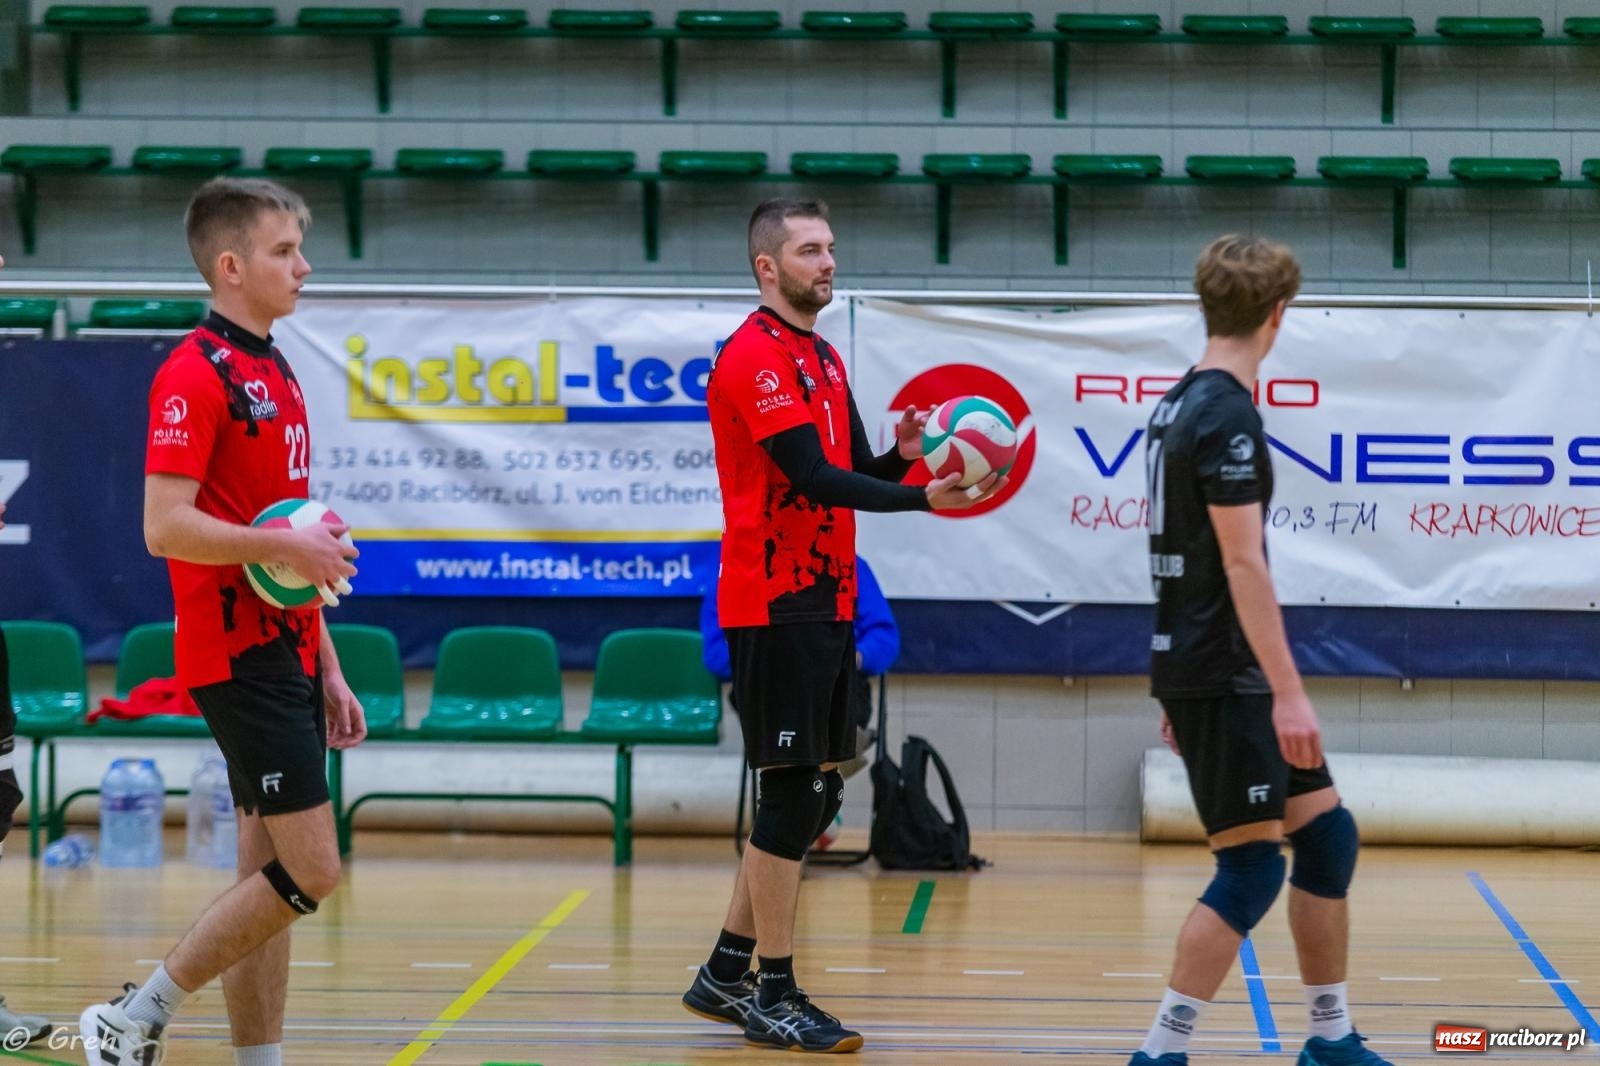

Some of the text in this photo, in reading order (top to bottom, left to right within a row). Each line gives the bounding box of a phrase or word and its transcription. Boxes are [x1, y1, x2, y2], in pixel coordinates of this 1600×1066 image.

[345, 335, 722, 404] instal-tec
[755, 393, 791, 408] POLSKA
[1075, 374, 1319, 407] RAIO
[154, 429, 188, 440] POLSKA
[285, 423, 308, 480] 22
[365, 448, 411, 467] 414
[418, 447, 448, 468] 92
[503, 450, 547, 471] 502
[555, 450, 600, 470] 632
[1073, 426, 1600, 487] VNES
[575, 487, 623, 504] von
[1325, 501, 1377, 535] FM
[416, 552, 693, 587] www.instal-tech.pl
